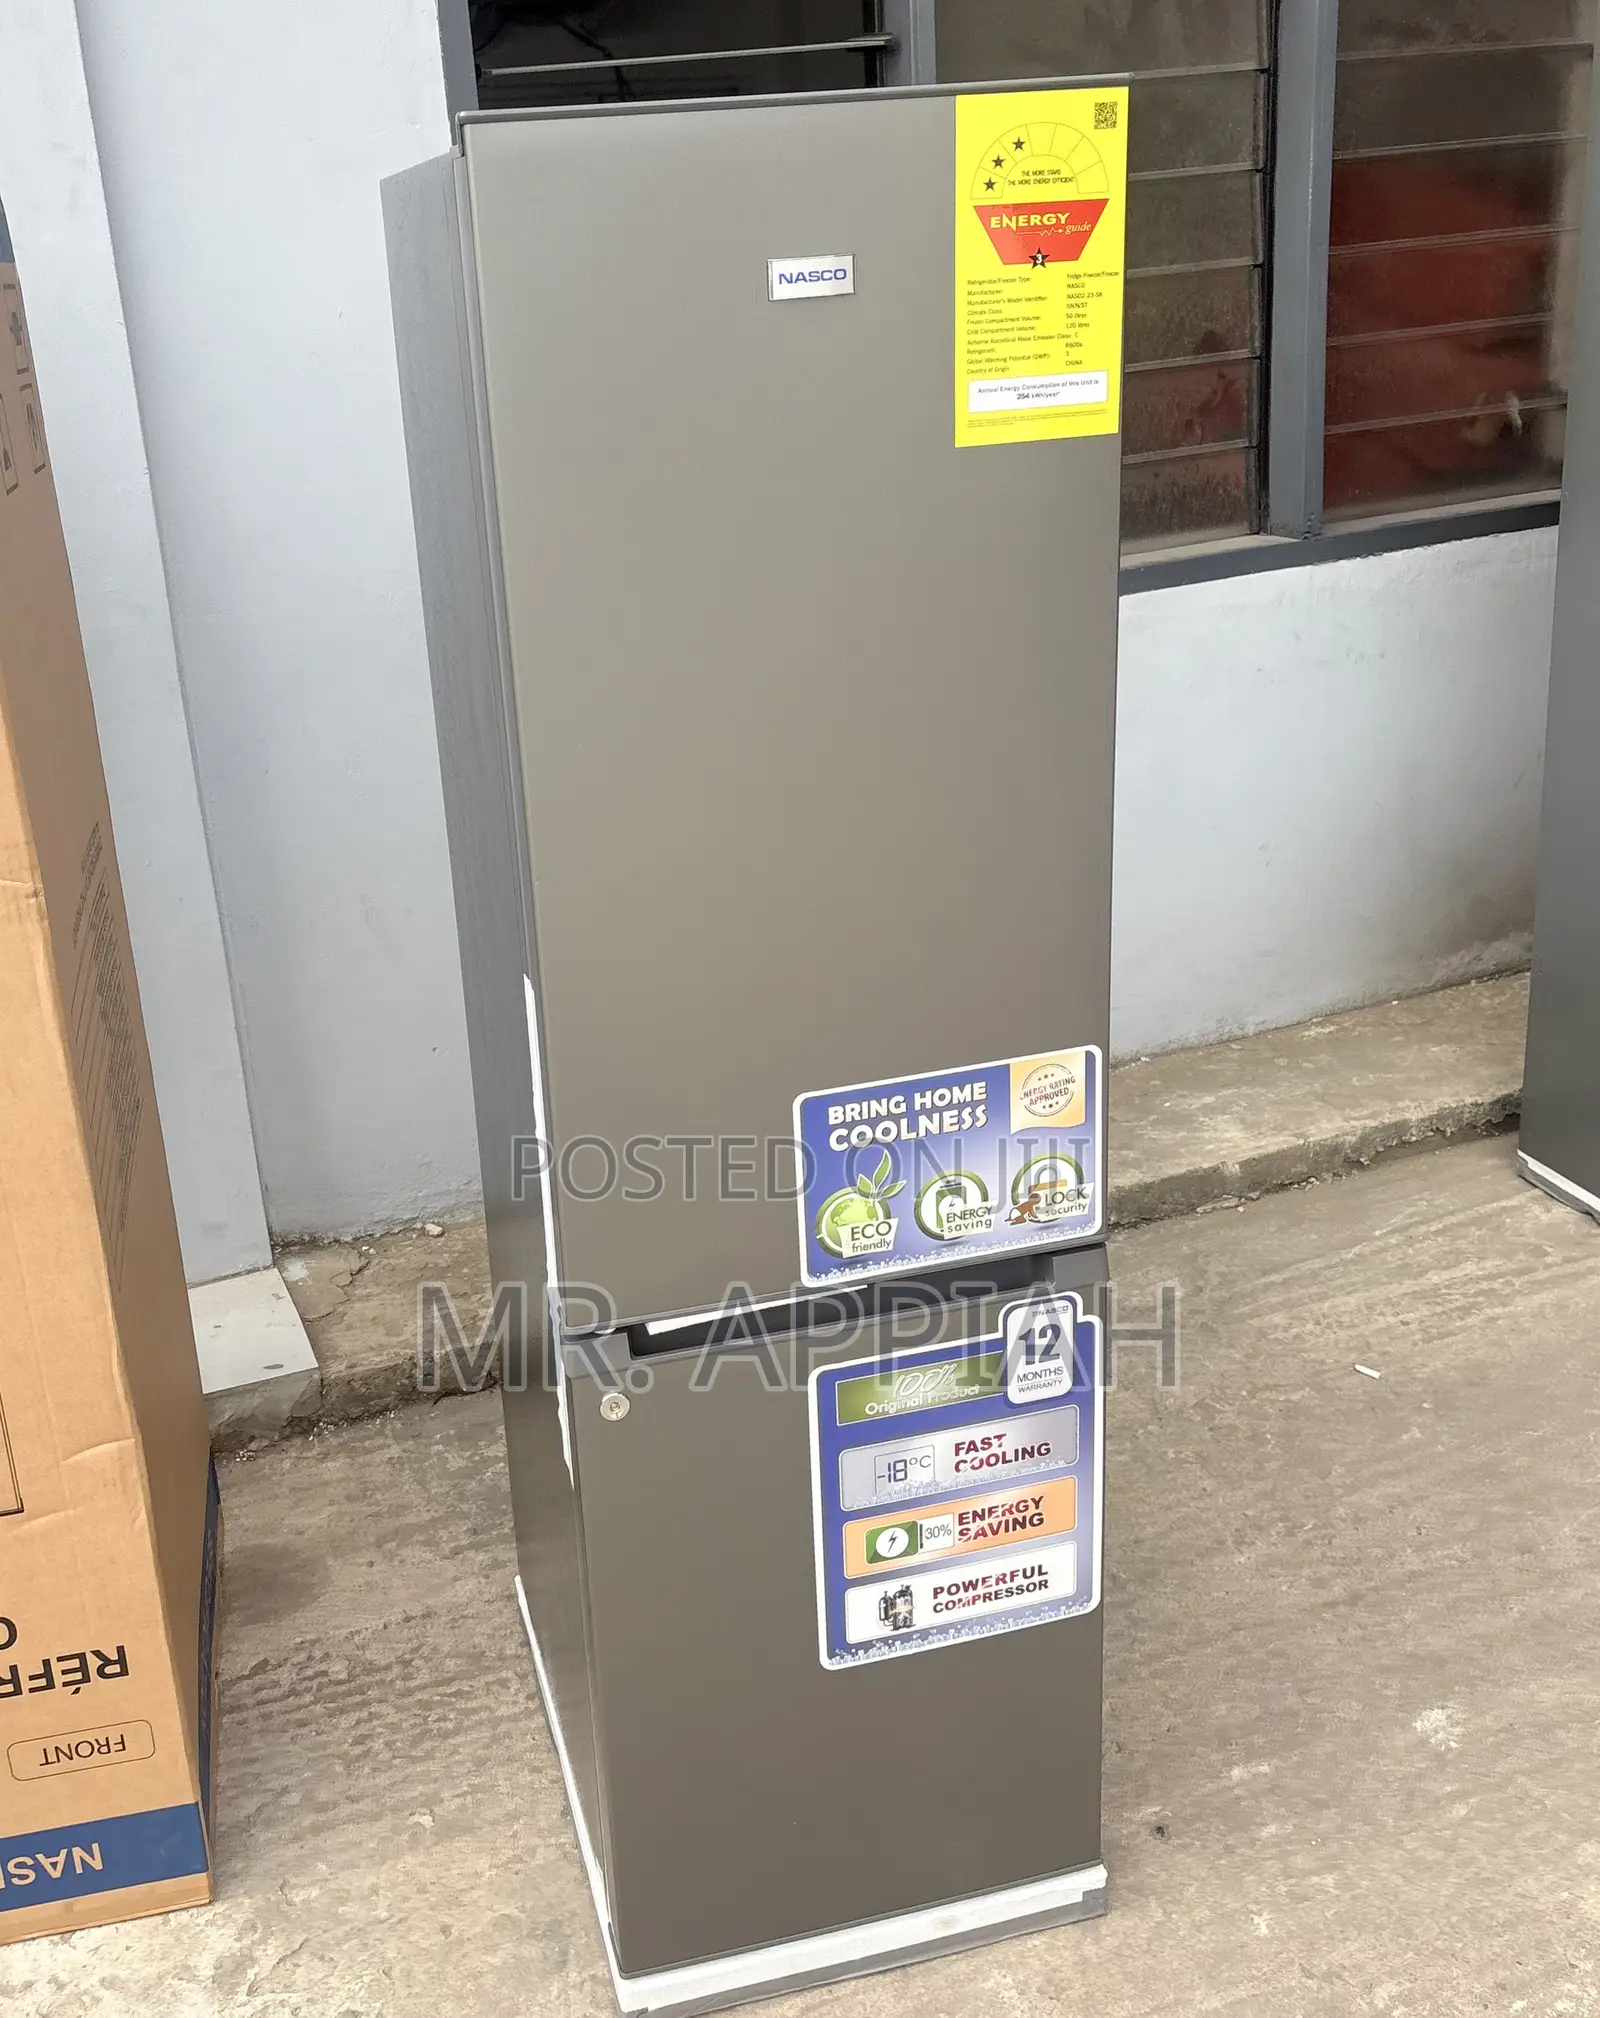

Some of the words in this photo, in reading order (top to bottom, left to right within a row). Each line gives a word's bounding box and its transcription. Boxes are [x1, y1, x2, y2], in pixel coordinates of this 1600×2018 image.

[990, 212, 1071, 231] ENERGY
[1065, 220, 1093, 235] guide
[1035, 253, 1043, 264] 3
[778, 268, 848, 284] NASCO
[978, 386, 999, 394] Annual
[1000, 385, 1020, 393] Energy
[1021, 382, 1060, 390] Consumption
[1068, 379, 1079, 387] this
[1048, 1075, 1076, 1090] RATING
[828, 1094, 907, 1126] BRING
[913, 1080, 988, 1113] HOME
[1029, 1087, 1070, 1107] APPROVED
[828, 1103, 989, 1152] COOLNESS
[1044, 1186, 1087, 1207] LOCK
[946, 1205, 993, 1224] ENERGY
[1045, 1201, 1088, 1217] security
[850, 1220, 893, 1243] ECO
[947, 1217, 993, 1234] saving
[851, 1237, 893, 1255] friendly
[1018, 1323, 1061, 1367] 12
[892, 1362, 958, 1399] 100%
[1016, 1365, 1064, 1384] MONTHS
[1017, 1379, 1063, 1394] WARRANTY
[864, 1392, 924, 1416] Original
[954, 1432, 1008, 1457] FAST
[954, 1441, 1052, 1474] COOLING
[957, 1495, 1045, 1527] ENERGY
[925, 1522, 952, 1541] 30%
[957, 1511, 1044, 1543] SAVING
[932, 1563, 1049, 1601] POWERFUL
[932, 1577, 1050, 1615] COMPRESSOR
[39, 1733, 127, 1768] FRONT
[0, 1841, 104, 1890] NAS
